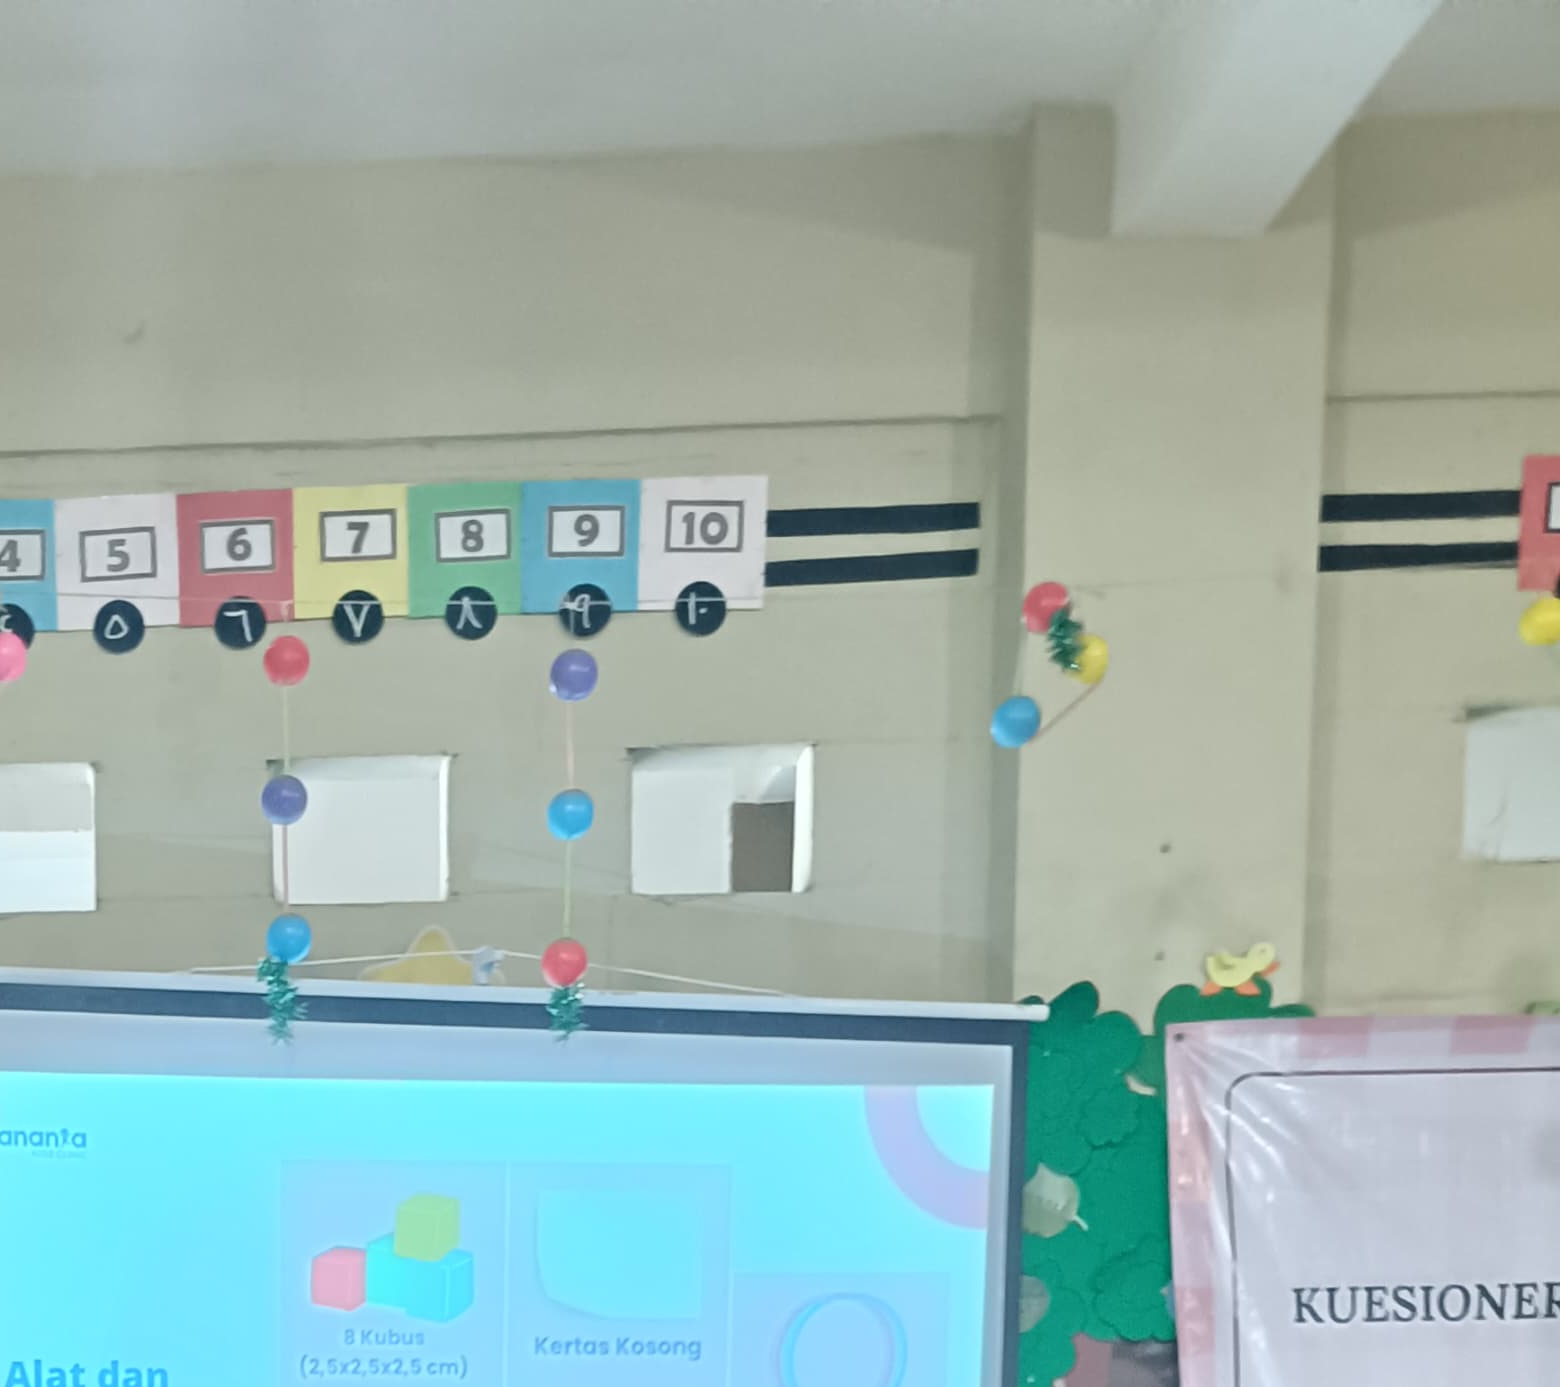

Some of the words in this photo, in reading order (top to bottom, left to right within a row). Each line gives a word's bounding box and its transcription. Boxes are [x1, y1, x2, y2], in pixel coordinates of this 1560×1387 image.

[106, 539, 130, 572] 5
[226, 528, 252, 561] 6
[346, 521, 370, 554] 7
[460, 519, 484, 552] 8
[574, 514, 599, 547] 9
[681, 511, 729, 546] 10
[361, 1328, 425, 1345] Kubus
[535, 1337, 609, 1355] Kertas
[615, 1337, 702, 1361] Kosong
